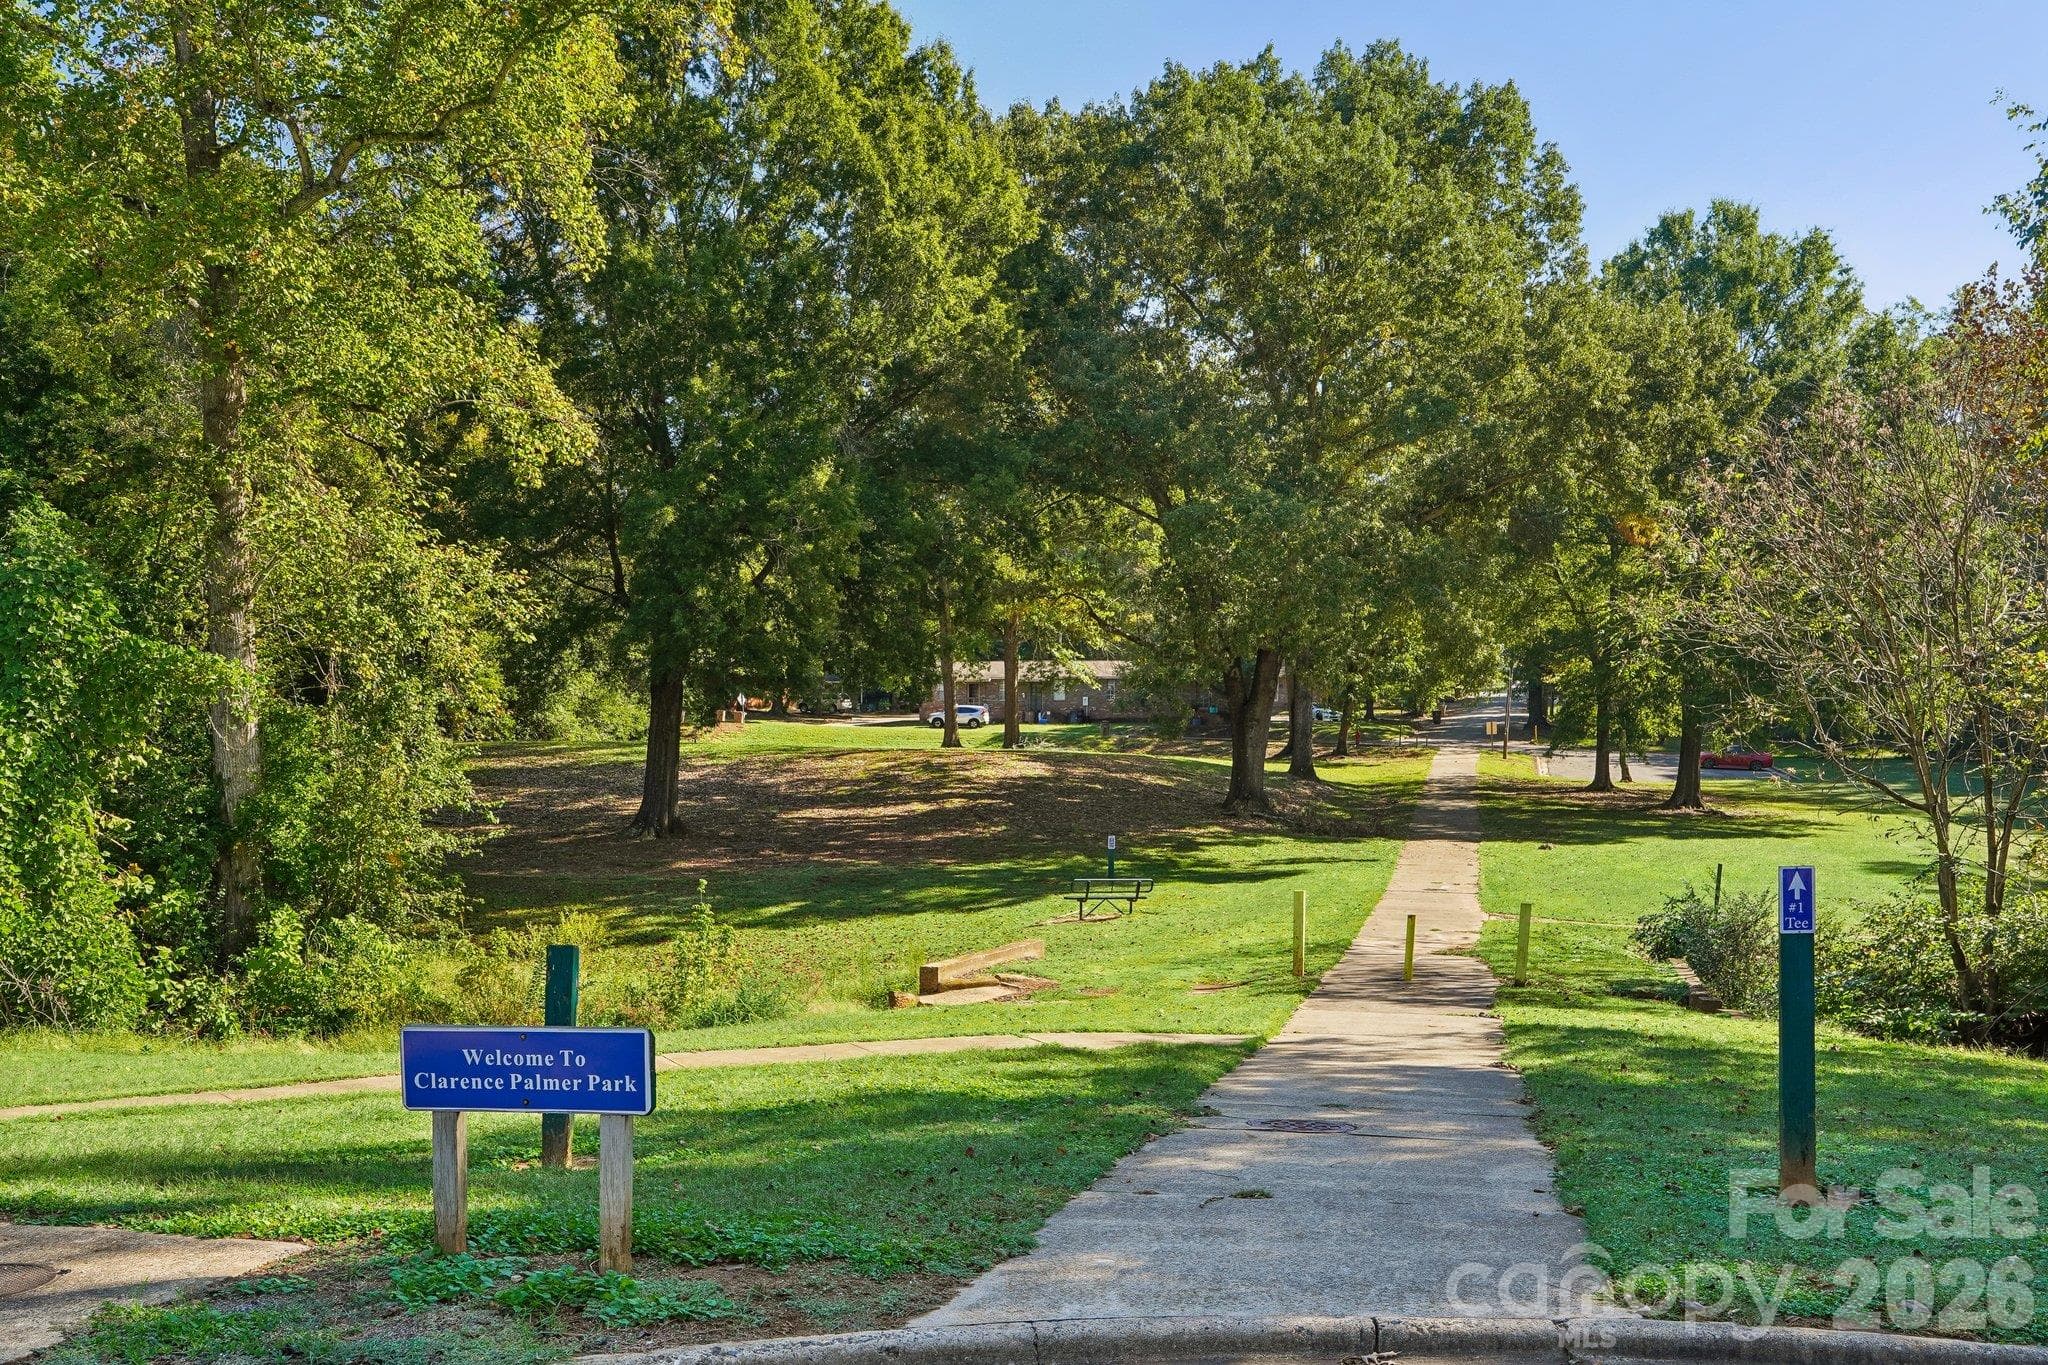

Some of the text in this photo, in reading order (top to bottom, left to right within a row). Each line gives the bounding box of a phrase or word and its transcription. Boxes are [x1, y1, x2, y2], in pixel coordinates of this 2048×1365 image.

[1788, 902, 1804, 913] #1
[1785, 917, 1809, 929] Tee
[462, 1048, 586, 1067] Welcome To
[414, 1072, 637, 1092] Clarence Palmer Park
